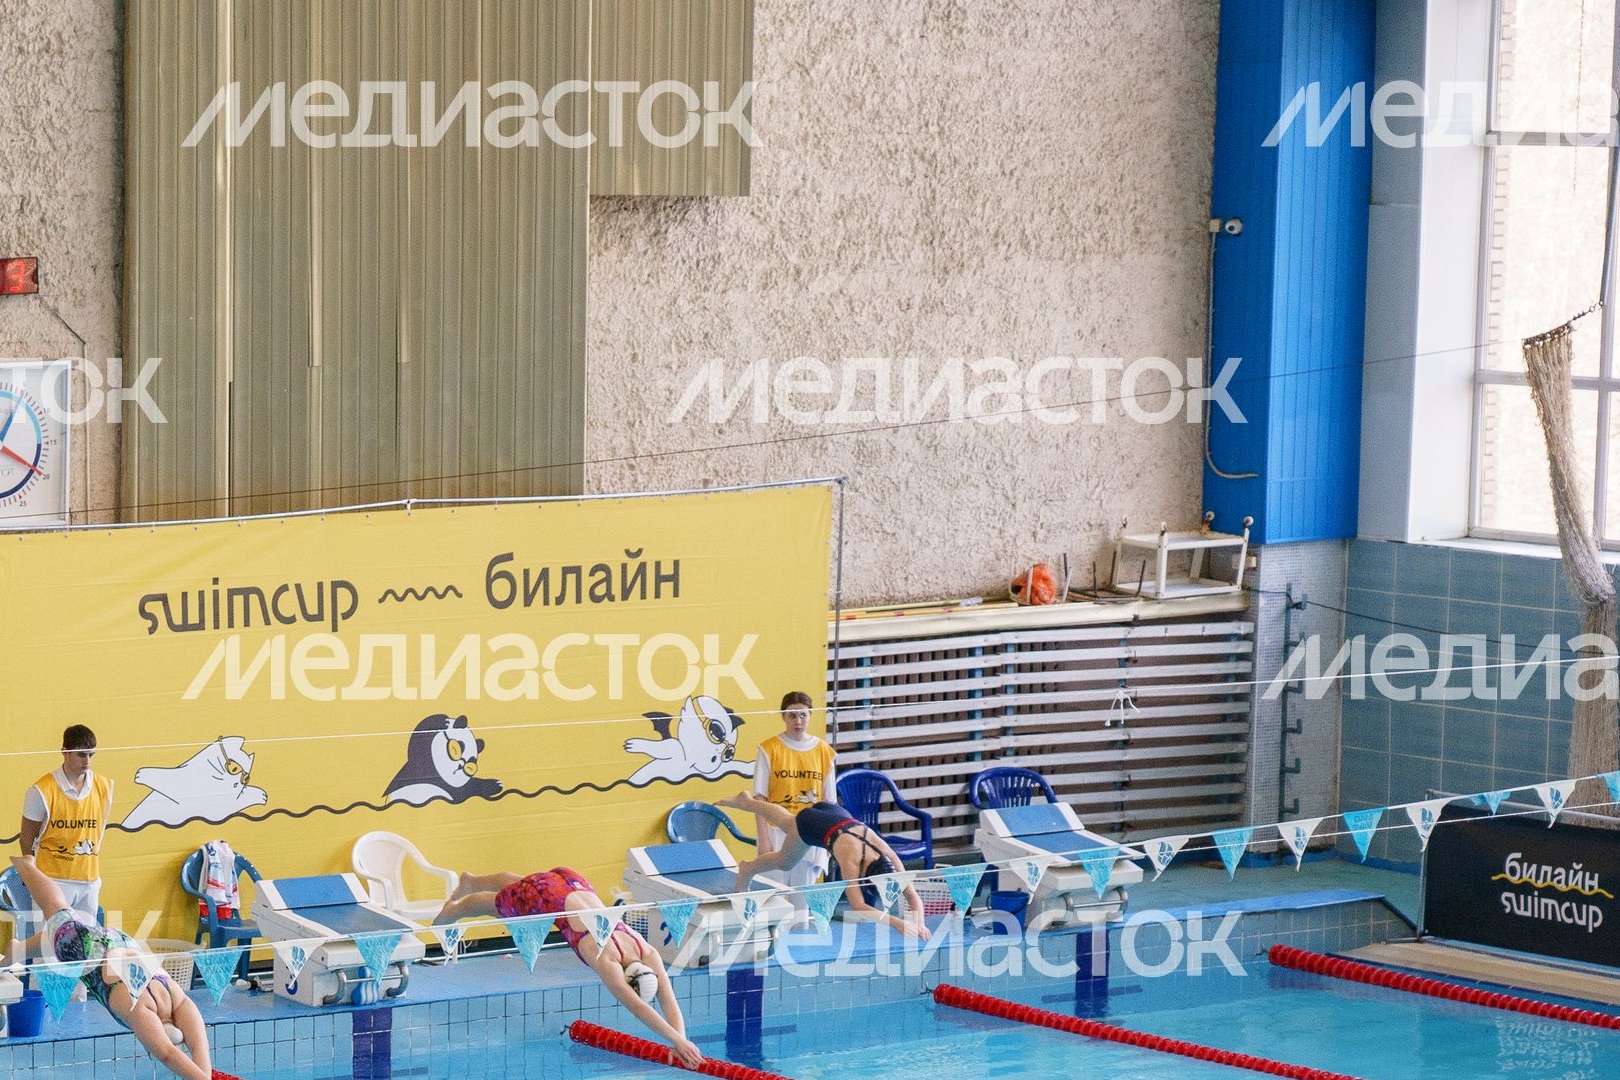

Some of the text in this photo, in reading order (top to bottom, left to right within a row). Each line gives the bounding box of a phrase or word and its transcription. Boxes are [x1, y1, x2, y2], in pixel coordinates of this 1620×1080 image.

[139, 547, 680, 634] swimcup билайн
[1505, 852, 1599, 892] билайн
[1501, 890, 1603, 933] swimcup
